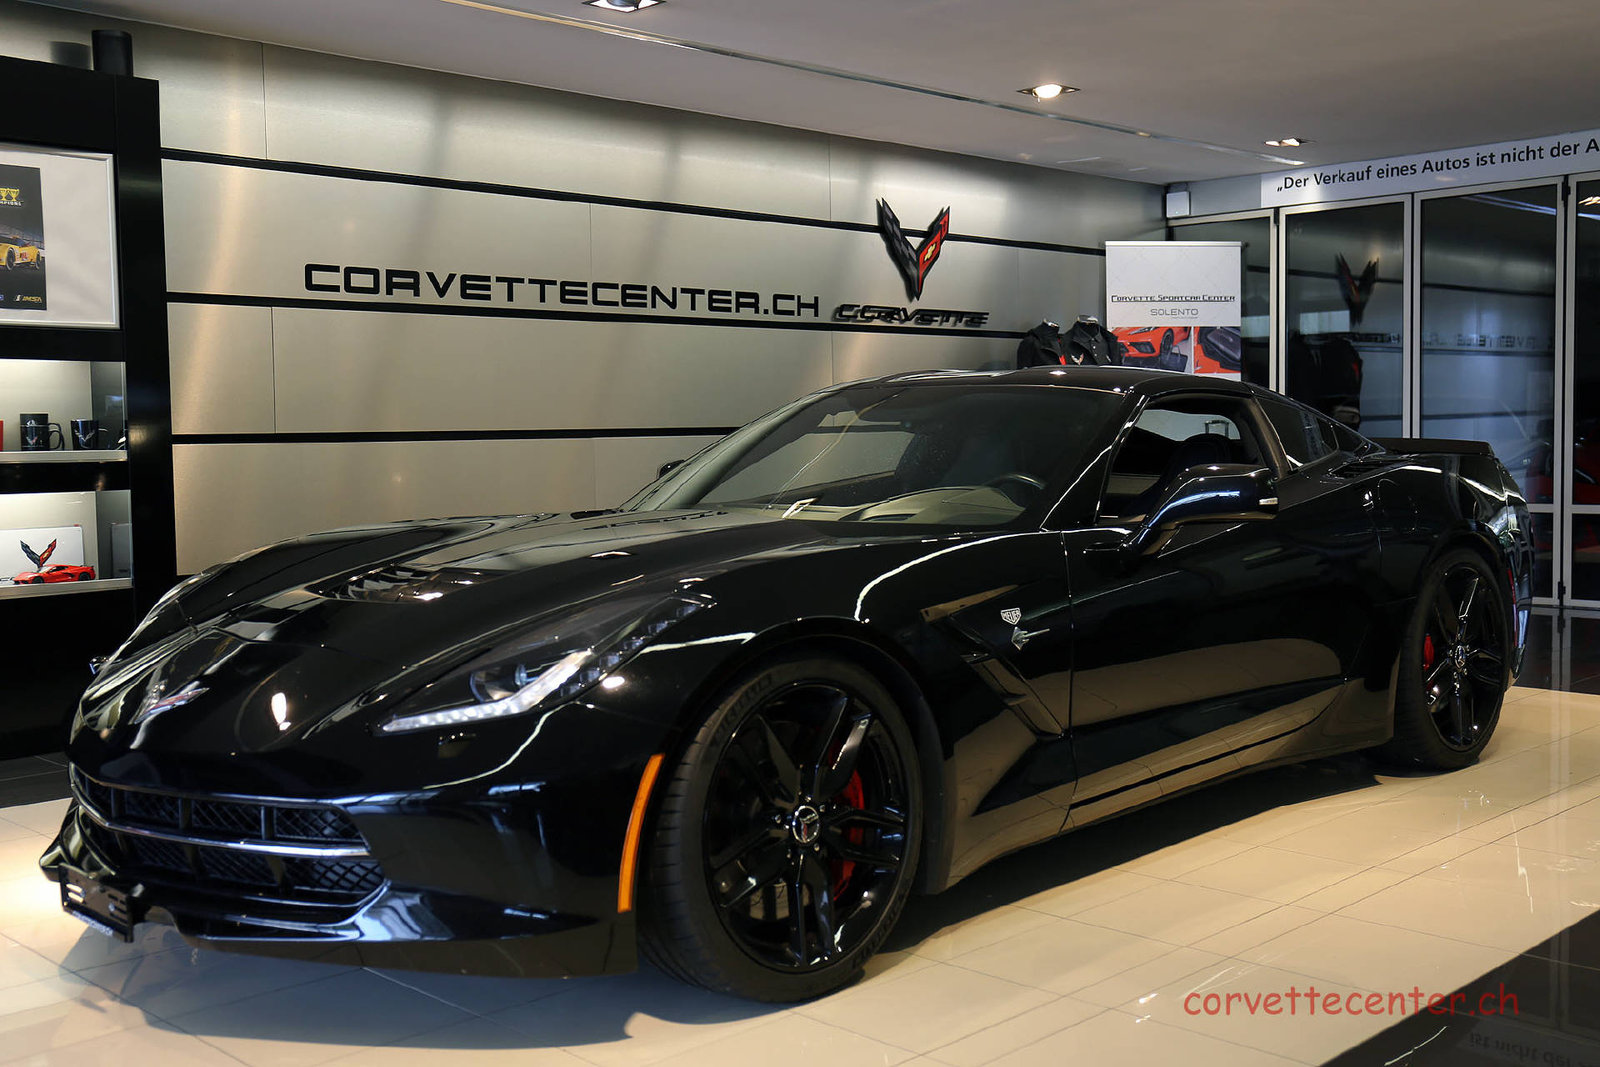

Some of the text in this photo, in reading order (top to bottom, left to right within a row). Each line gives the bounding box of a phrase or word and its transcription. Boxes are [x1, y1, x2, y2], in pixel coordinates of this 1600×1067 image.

[1314, 165, 1371, 185] Verkauf
[1377, 162, 1417, 179] eines
[1422, 156, 1470, 173] Autos
[1475, 152, 1496, 166] ist
[1501, 144, 1545, 163] nicht
[1550, 138, 1580, 157] der
[304, 263, 820, 318] CORVETTECENTER.CH
[833, 303, 990, 327] CORVETTE
[1150, 308, 1199, 316] SOLENTO
